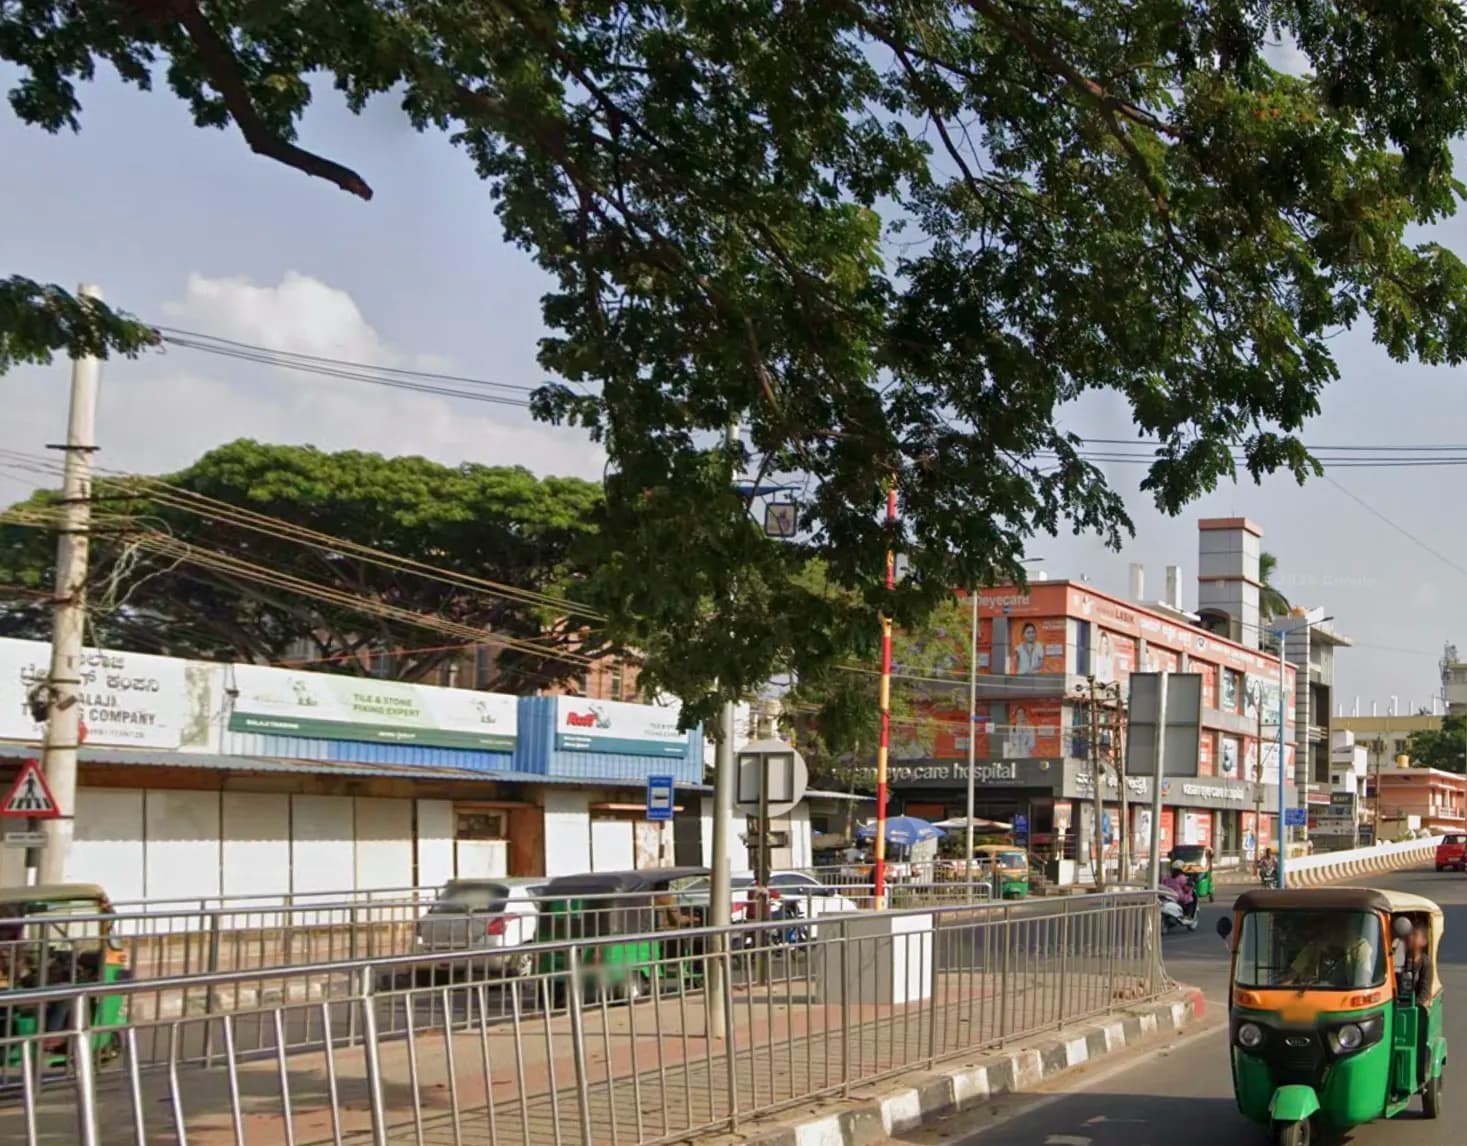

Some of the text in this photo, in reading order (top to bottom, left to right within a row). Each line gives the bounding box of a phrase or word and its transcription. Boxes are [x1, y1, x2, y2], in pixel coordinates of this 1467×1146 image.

[89, 708, 156, 725] COMPANY
[914, 766, 949, 780] care
[953, 762, 1016, 783] hospital
